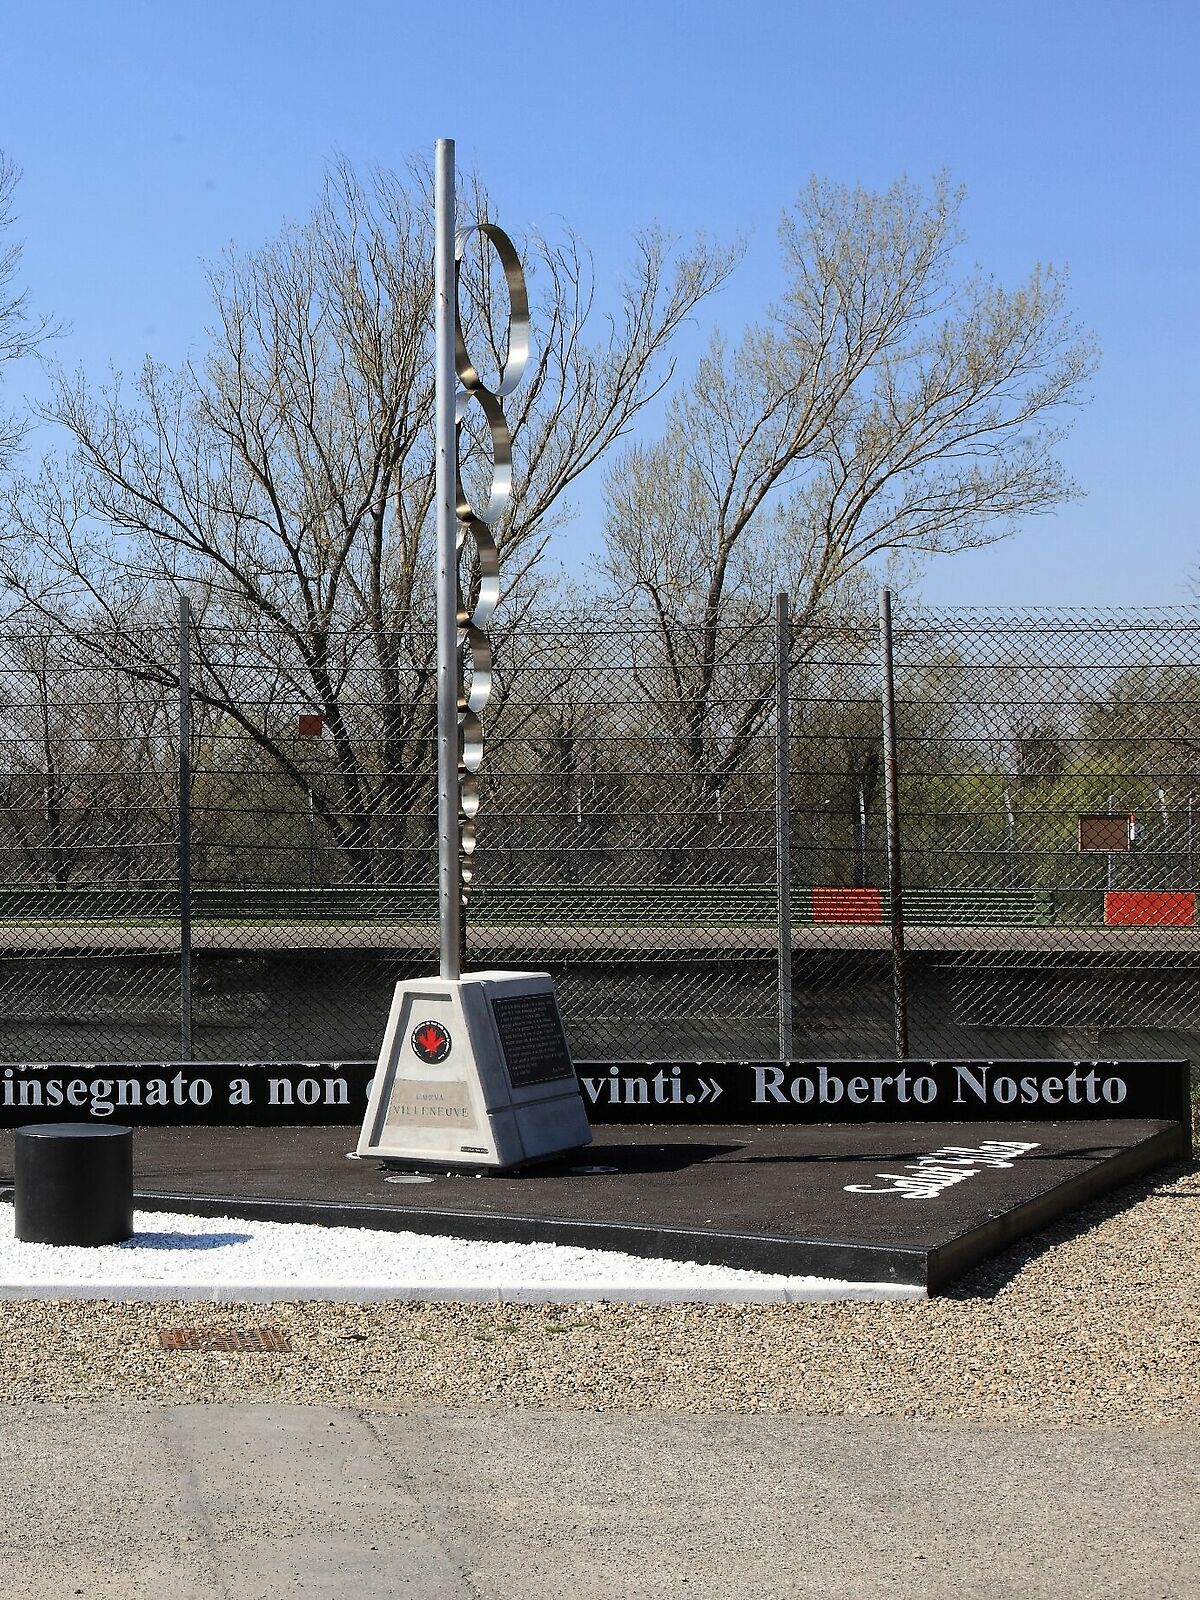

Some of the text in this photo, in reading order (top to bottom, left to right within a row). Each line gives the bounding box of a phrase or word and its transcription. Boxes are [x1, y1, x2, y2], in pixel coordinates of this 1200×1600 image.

[2, 1068, 213, 1117] insegnato
[229, 1079, 253, 1105] a
[267, 1077, 350, 1105] non
[580, 1065, 724, 1104] vinti.»
[750, 1066, 938, 1104] Roberto
[952, 1066, 1128, 1104] Nosetto
[394, 1105, 469, 1118] VILLENEUVE
